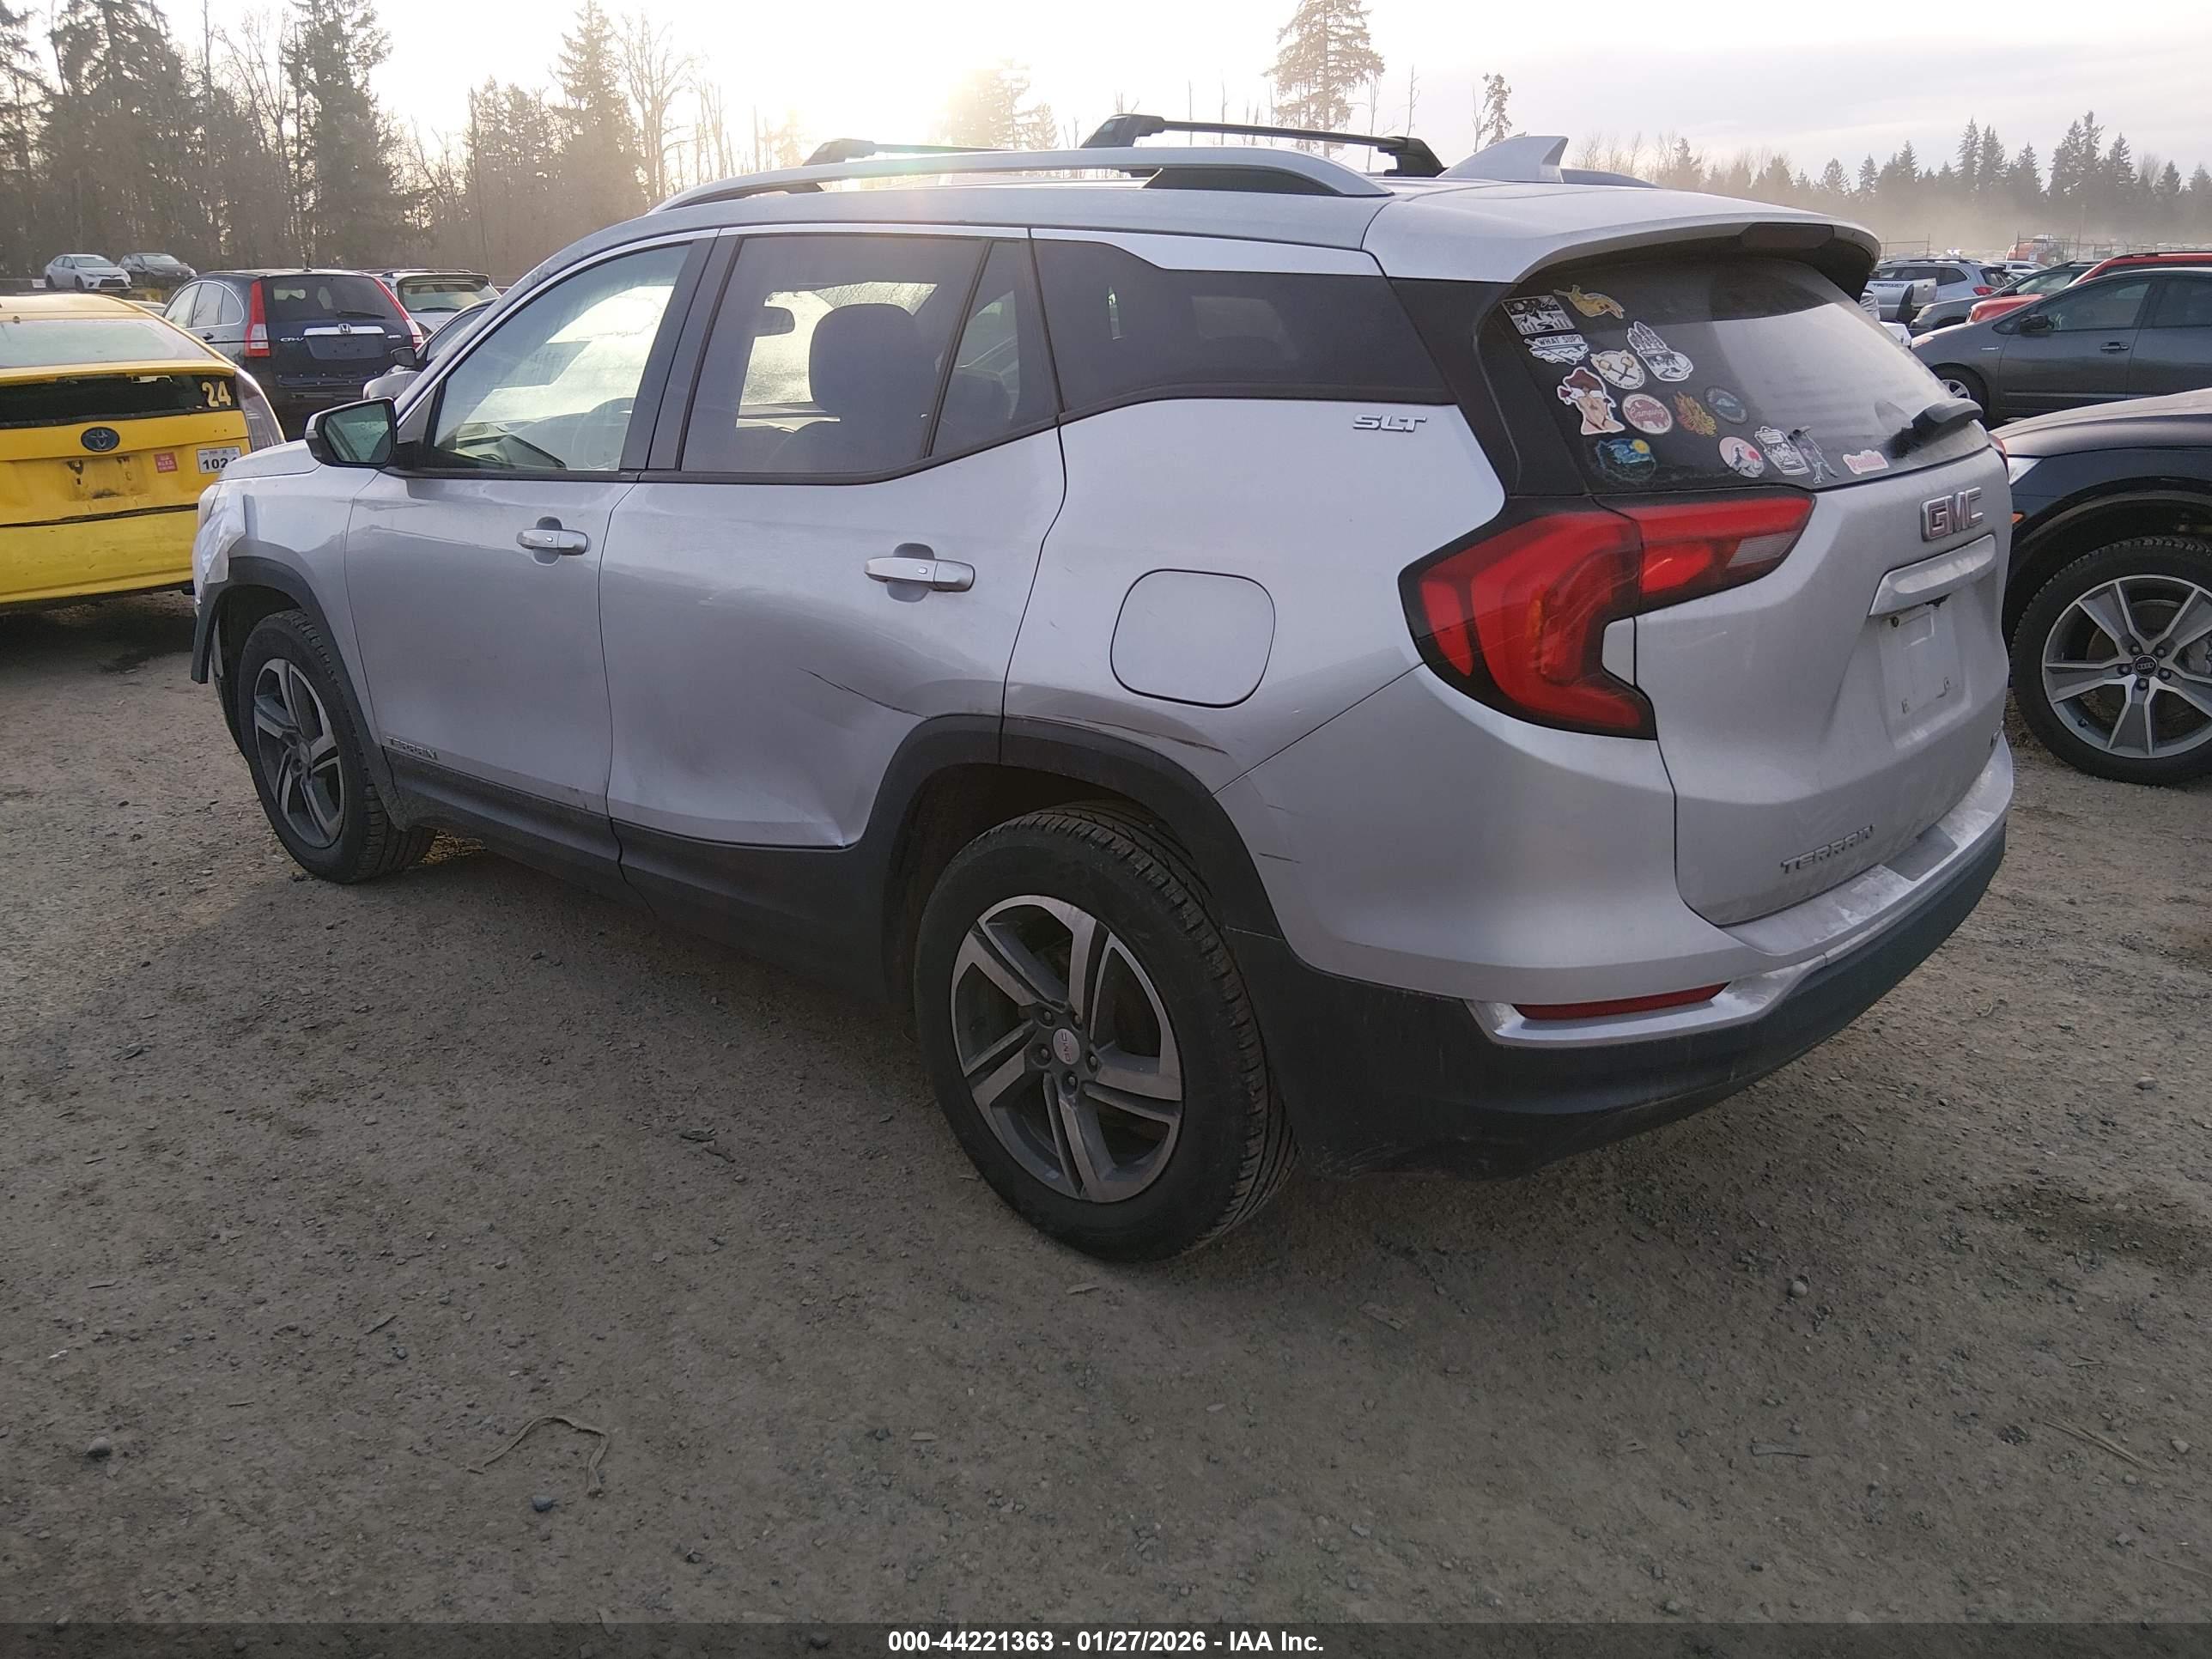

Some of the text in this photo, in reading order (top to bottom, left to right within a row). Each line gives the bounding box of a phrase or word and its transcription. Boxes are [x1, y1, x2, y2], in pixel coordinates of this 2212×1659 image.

[1537, 337, 1560, 346] WHAT
[201, 380, 233, 408] 24
[1353, 413, 1427, 433] SLT
[202, 457, 238, 471] 102
[1920, 487, 1984, 543] GMC
[1779, 823, 1875, 874] TERRAIN
